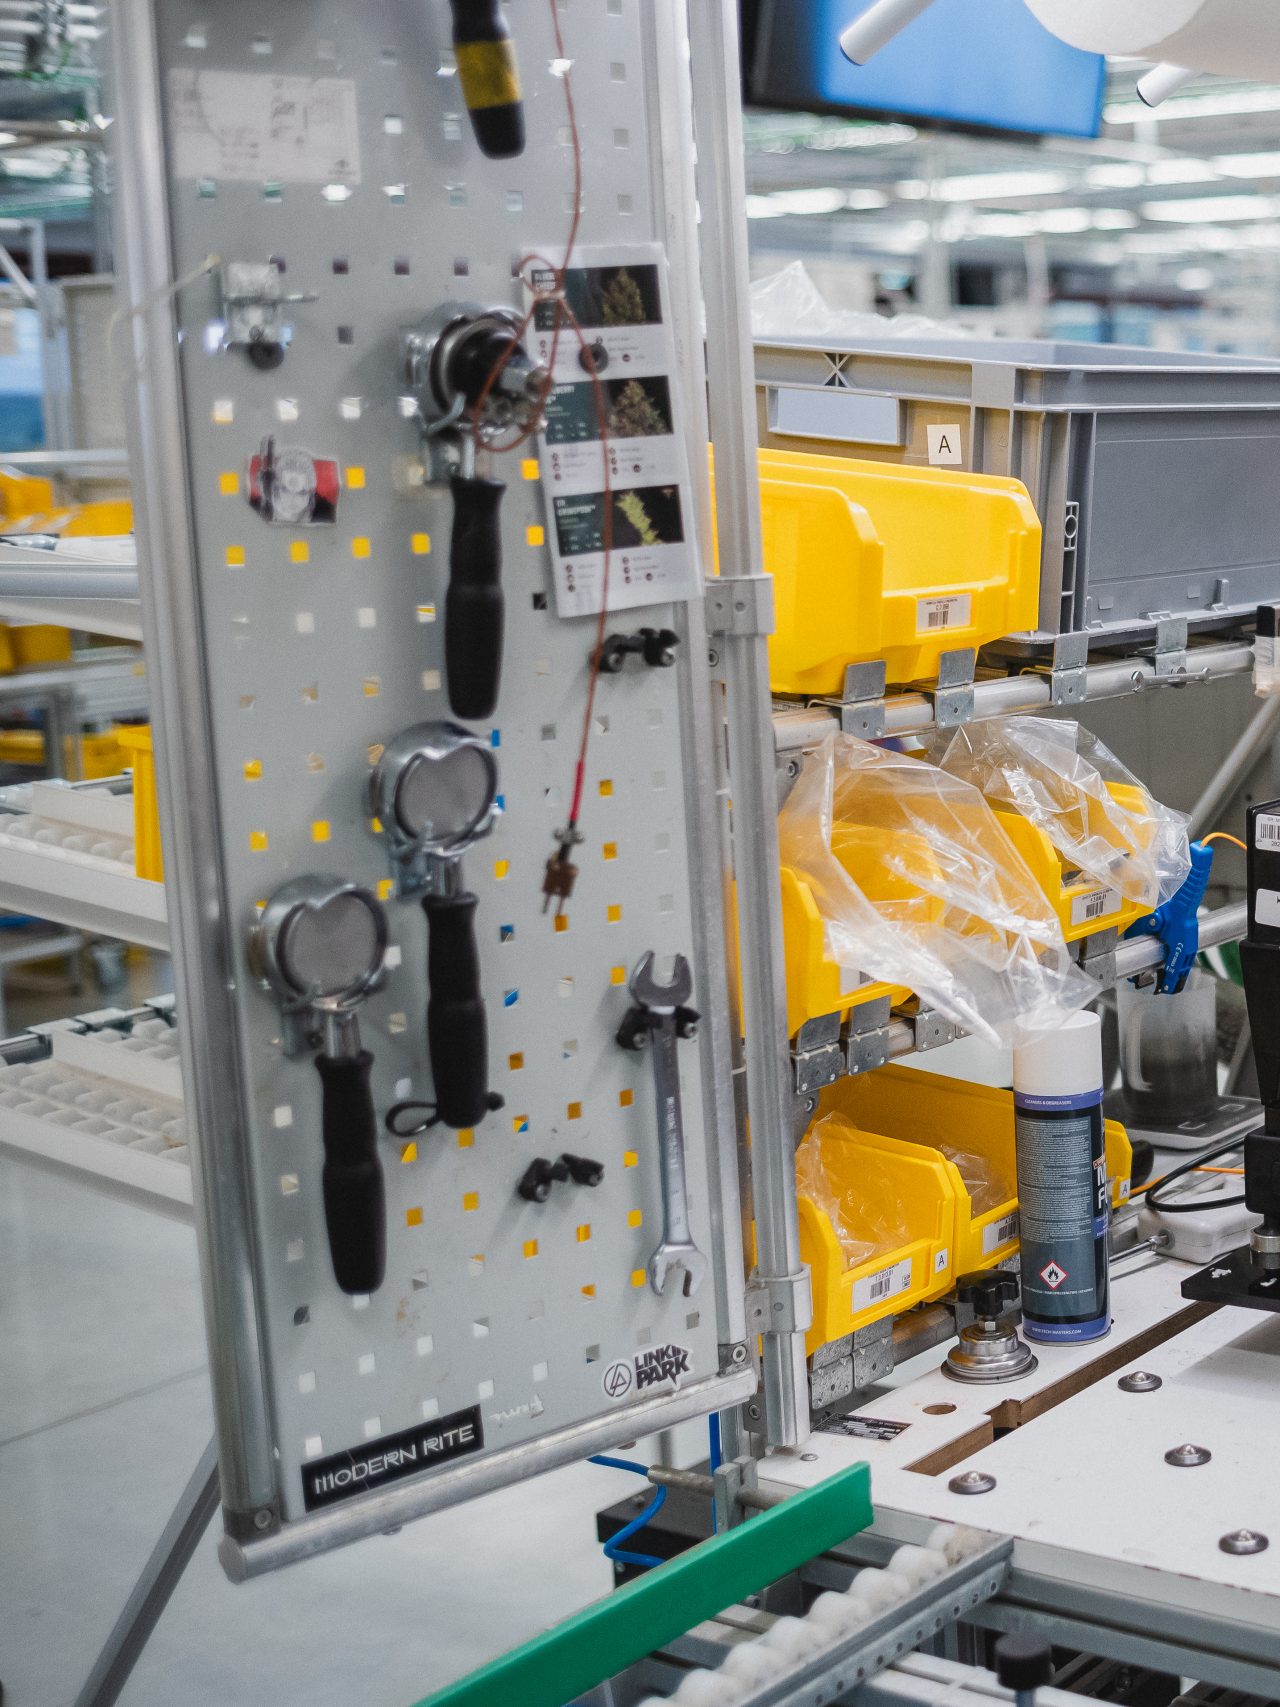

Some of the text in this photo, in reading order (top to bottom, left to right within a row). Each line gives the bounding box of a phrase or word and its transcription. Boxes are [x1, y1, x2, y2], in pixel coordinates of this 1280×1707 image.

[938, 434, 952, 454] A
[938, 1254, 945, 1268] A
[636, 1353, 690, 1390] PARK
[315, 1423, 475, 1495] MODERN RITE
